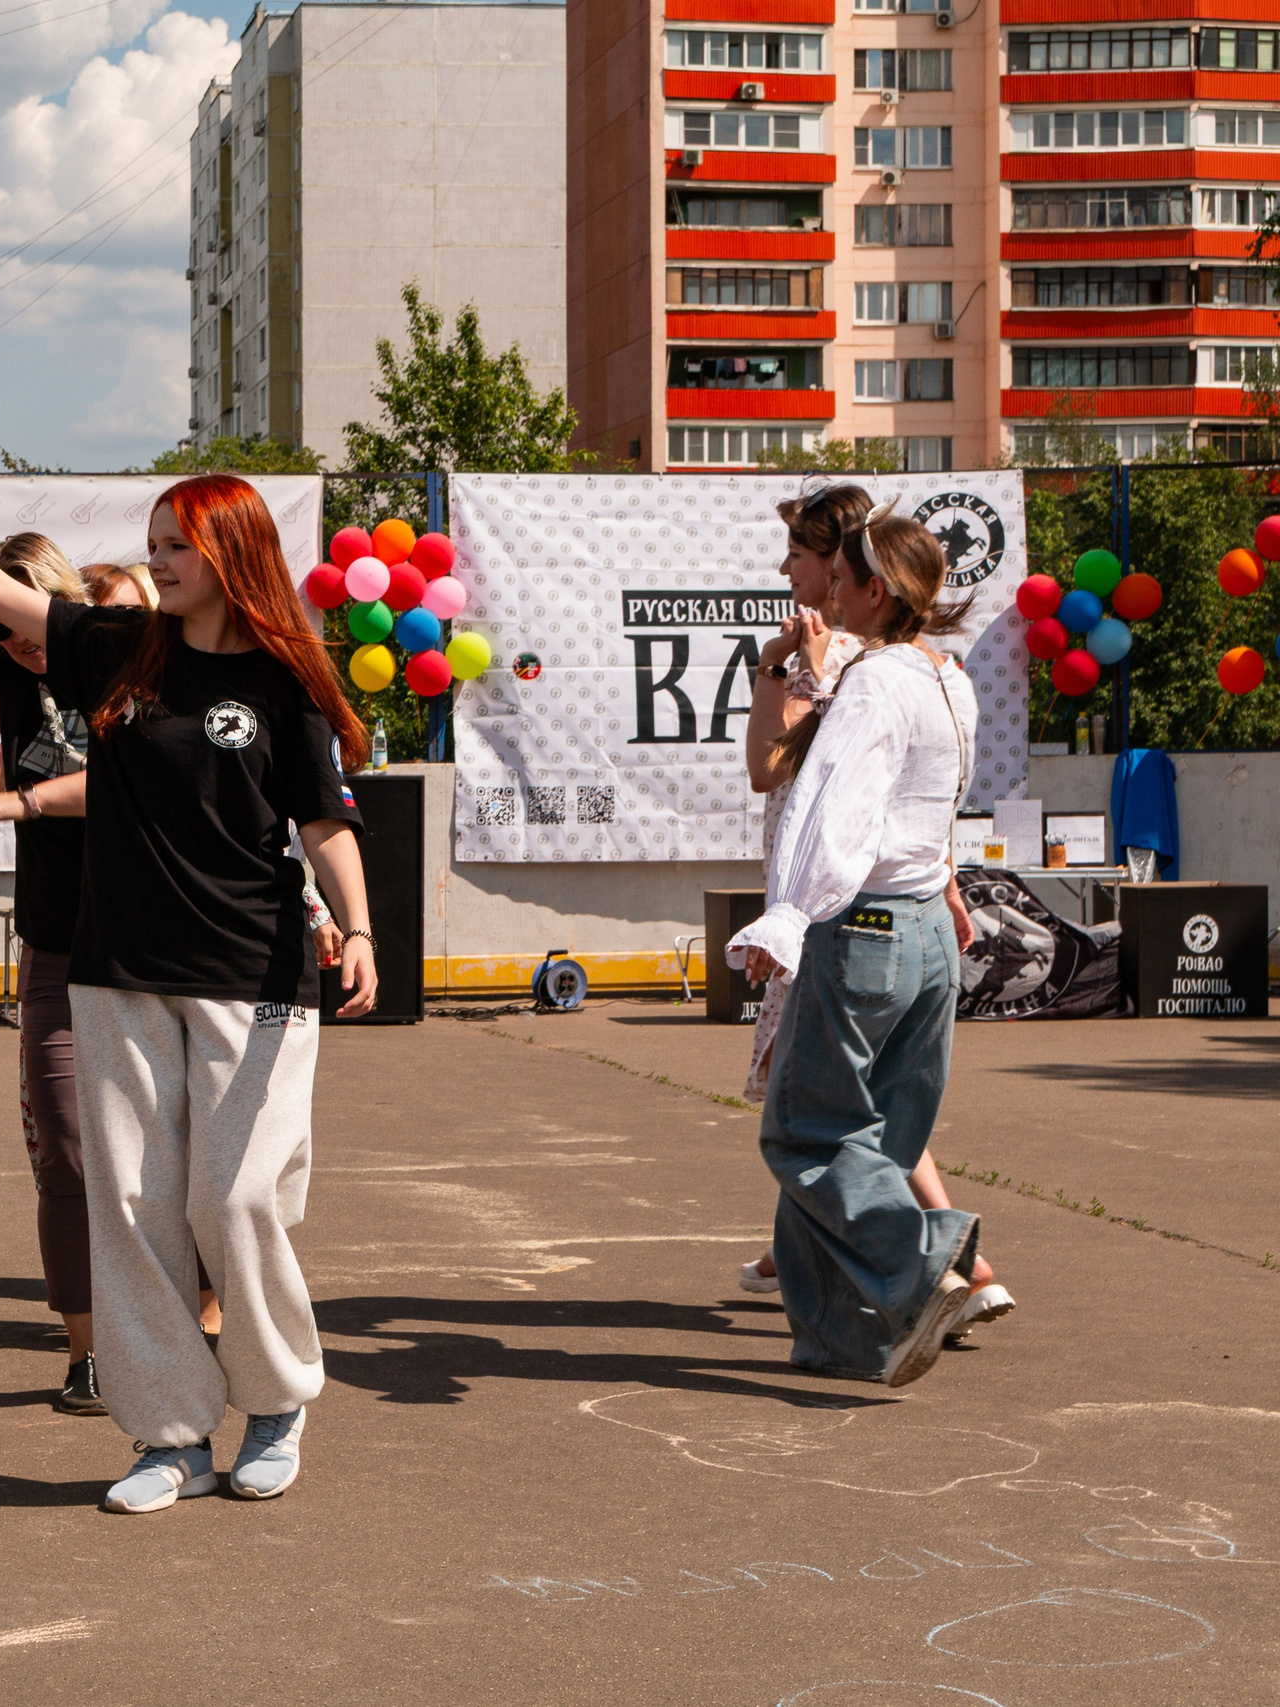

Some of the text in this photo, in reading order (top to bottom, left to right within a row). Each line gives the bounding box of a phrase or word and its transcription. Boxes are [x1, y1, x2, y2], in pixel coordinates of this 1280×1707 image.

[913, 493, 998, 525] УССКАЯ
[627, 599, 797, 623] РУССКАЯ ОБЩ
[1172, 978, 1232, 996] ПОМОЩЬ
[1157, 998, 1247, 1015] ГОСПИТАЛЮ
